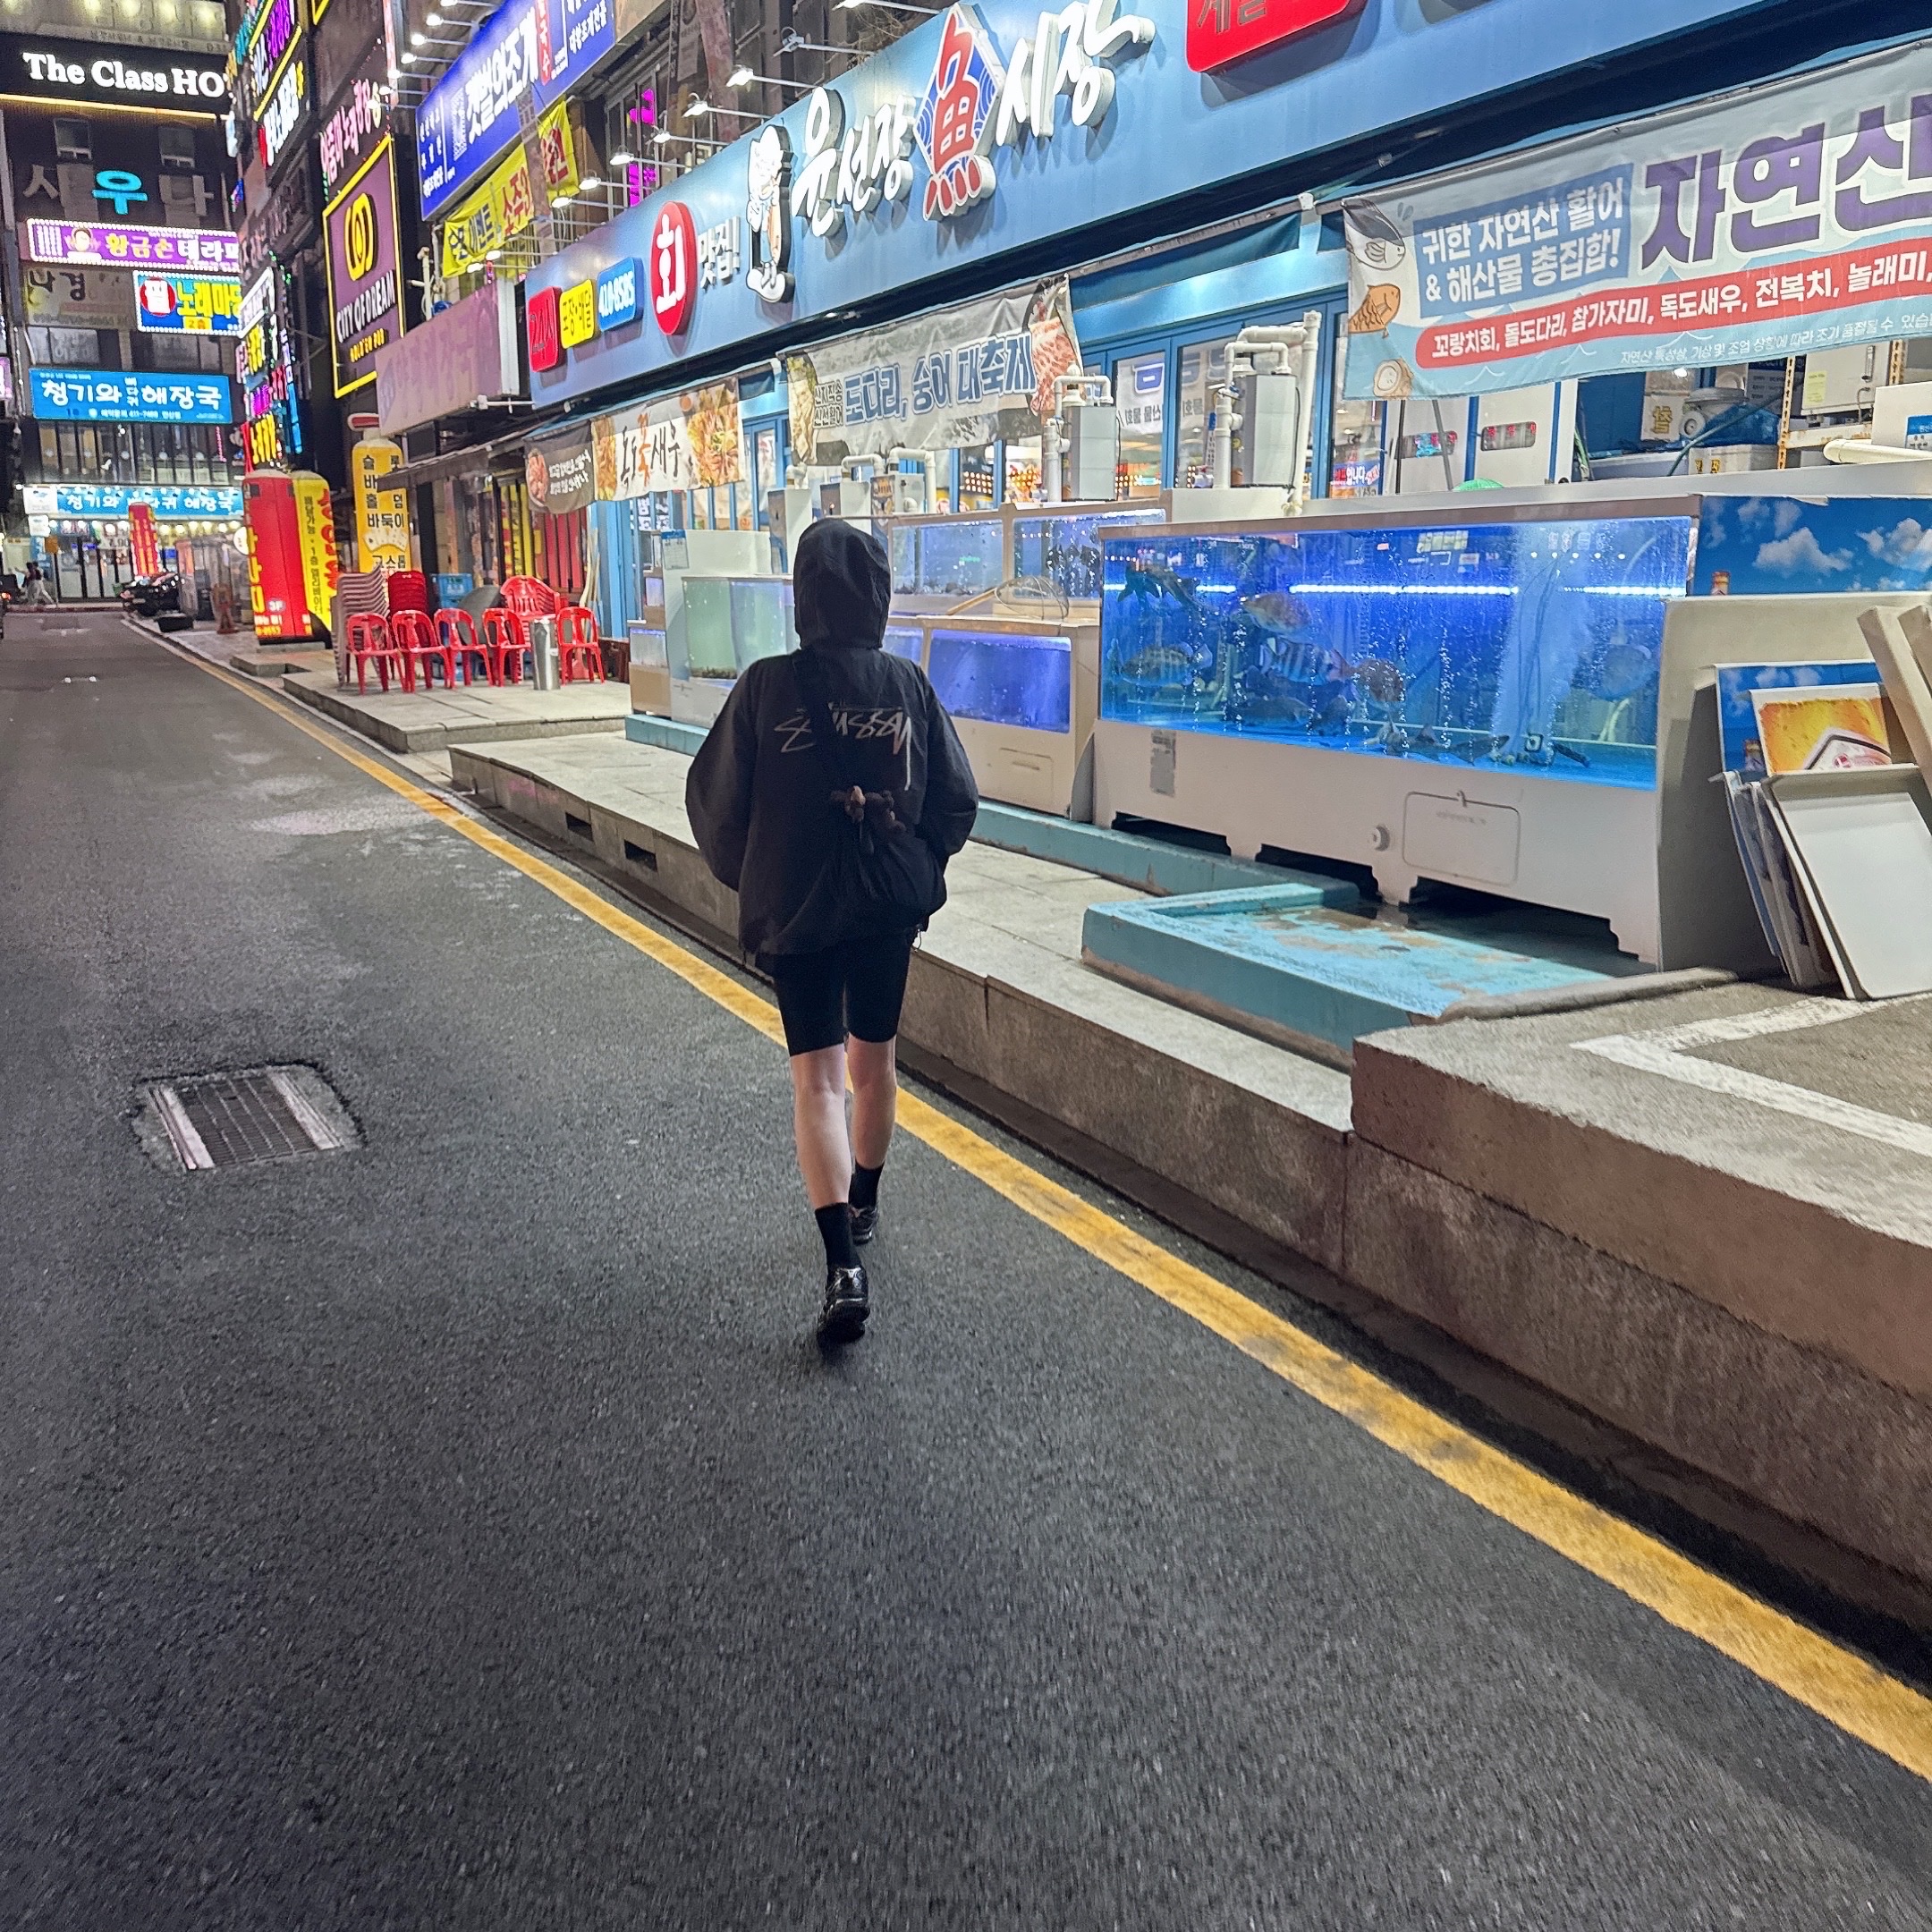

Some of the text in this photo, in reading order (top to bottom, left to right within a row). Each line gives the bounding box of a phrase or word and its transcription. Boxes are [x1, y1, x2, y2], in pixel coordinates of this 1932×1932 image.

[21, 52, 228, 98] The Class HO
[996, 0, 1155, 146] 시장
[792, 86, 916, 237] 윤선장
[1642, 93, 1932, 271] 자연산
[1422, 177, 1624, 266] 귀한 자연산 활어
[656, 213, 741, 315] 회 맛집!
[1425, 227, 1622, 303] & 해산물 총집합!
[1504, 313, 1567, 348] 돌도다리,
[1572, 296, 1655, 334] 참가자미,
[1660, 284, 1748, 321] 독도새우,
[1755, 268, 1840, 309] 전복치,
[1848, 250, 1932, 293] 놀래미,
[336, 302, 354, 343] CITY
[1621, 349, 1653, 364] 자연산
[1728, 340, 1750, 356] 조업
[1816, 325, 1840, 343] 조기
[1880, 318, 1894, 331] 수
[1902, 313, 1932, 330] 있습
[41, 378, 123, 407] 청기와
[141, 385, 223, 411] 해장국
[845, 363, 908, 425] 도다리,
[912, 353, 953, 414] 숭어
[957, 331, 1037, 404] 대축제
[67, 493, 120, 511] 청기와
[183, 496, 234, 513] 해장국
[368, 513, 404, 529] 바둑이
